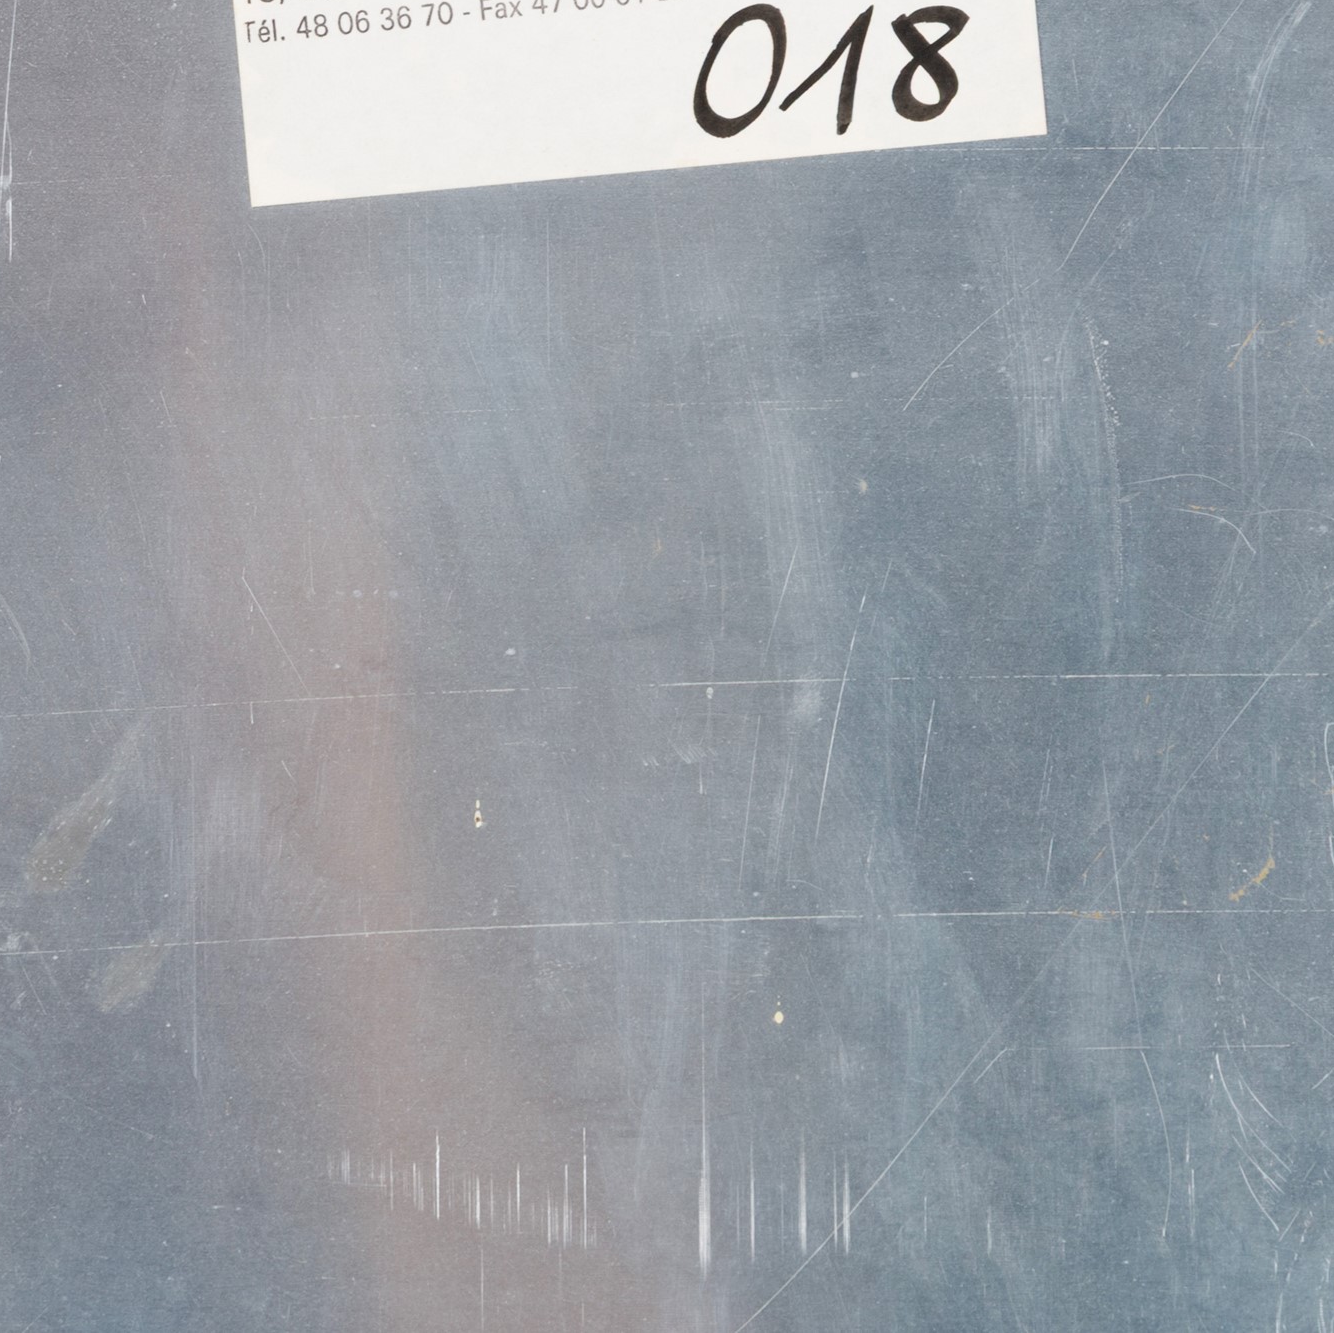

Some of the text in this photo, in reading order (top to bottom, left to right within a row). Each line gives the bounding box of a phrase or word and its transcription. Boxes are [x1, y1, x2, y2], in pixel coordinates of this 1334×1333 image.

[296, 13, 329, 39] 48
[337, 9, 371, 36] 06
[380, 5, 412, 32] 36
[421, 1, 454, 27] 70
[692, 2, 971, 140] 018
